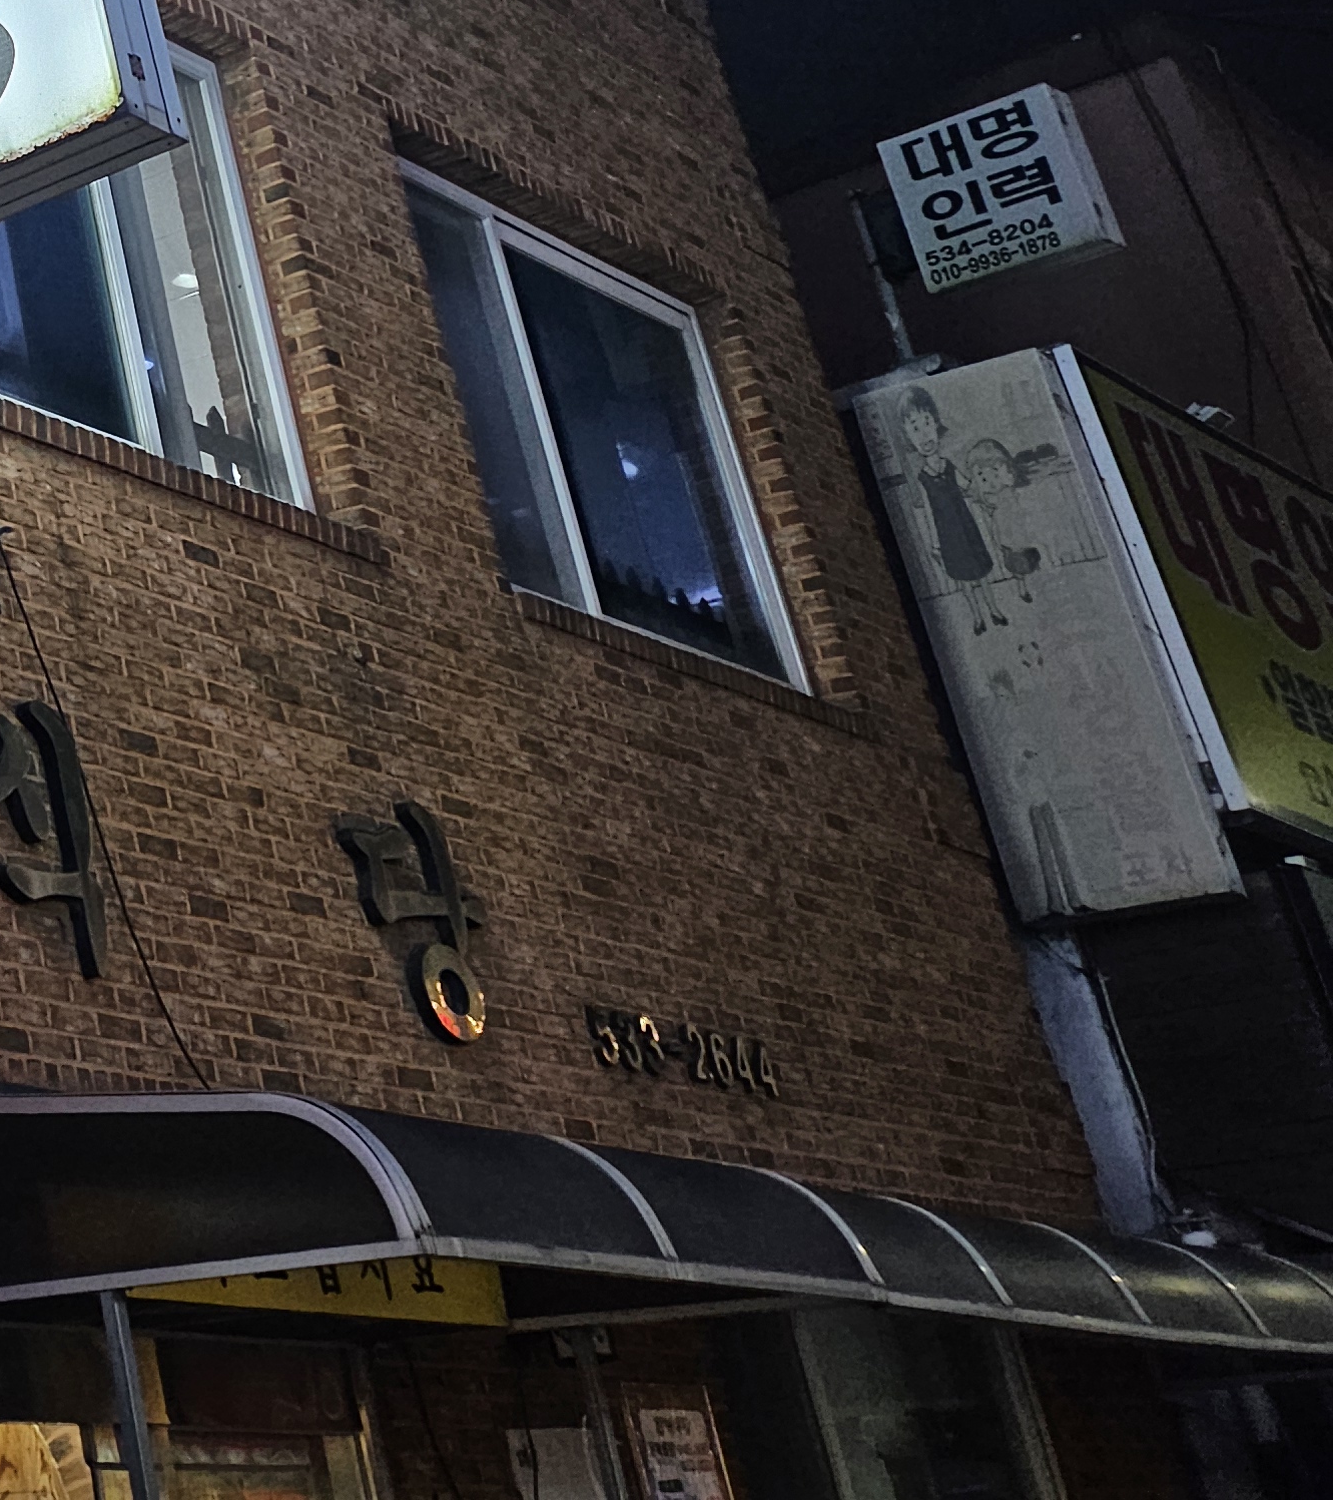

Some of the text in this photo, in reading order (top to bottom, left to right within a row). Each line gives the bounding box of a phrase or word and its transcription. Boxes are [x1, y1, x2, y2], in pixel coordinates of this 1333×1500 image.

[900, 99, 1040, 181] 대명
[921, 155, 1064, 241] 인력
[925, 213, 1054, 267] 534-8204
[930, 231, 1061, 285] 010-9936-1878
[587, 1006, 780, 1098] 533-2644
